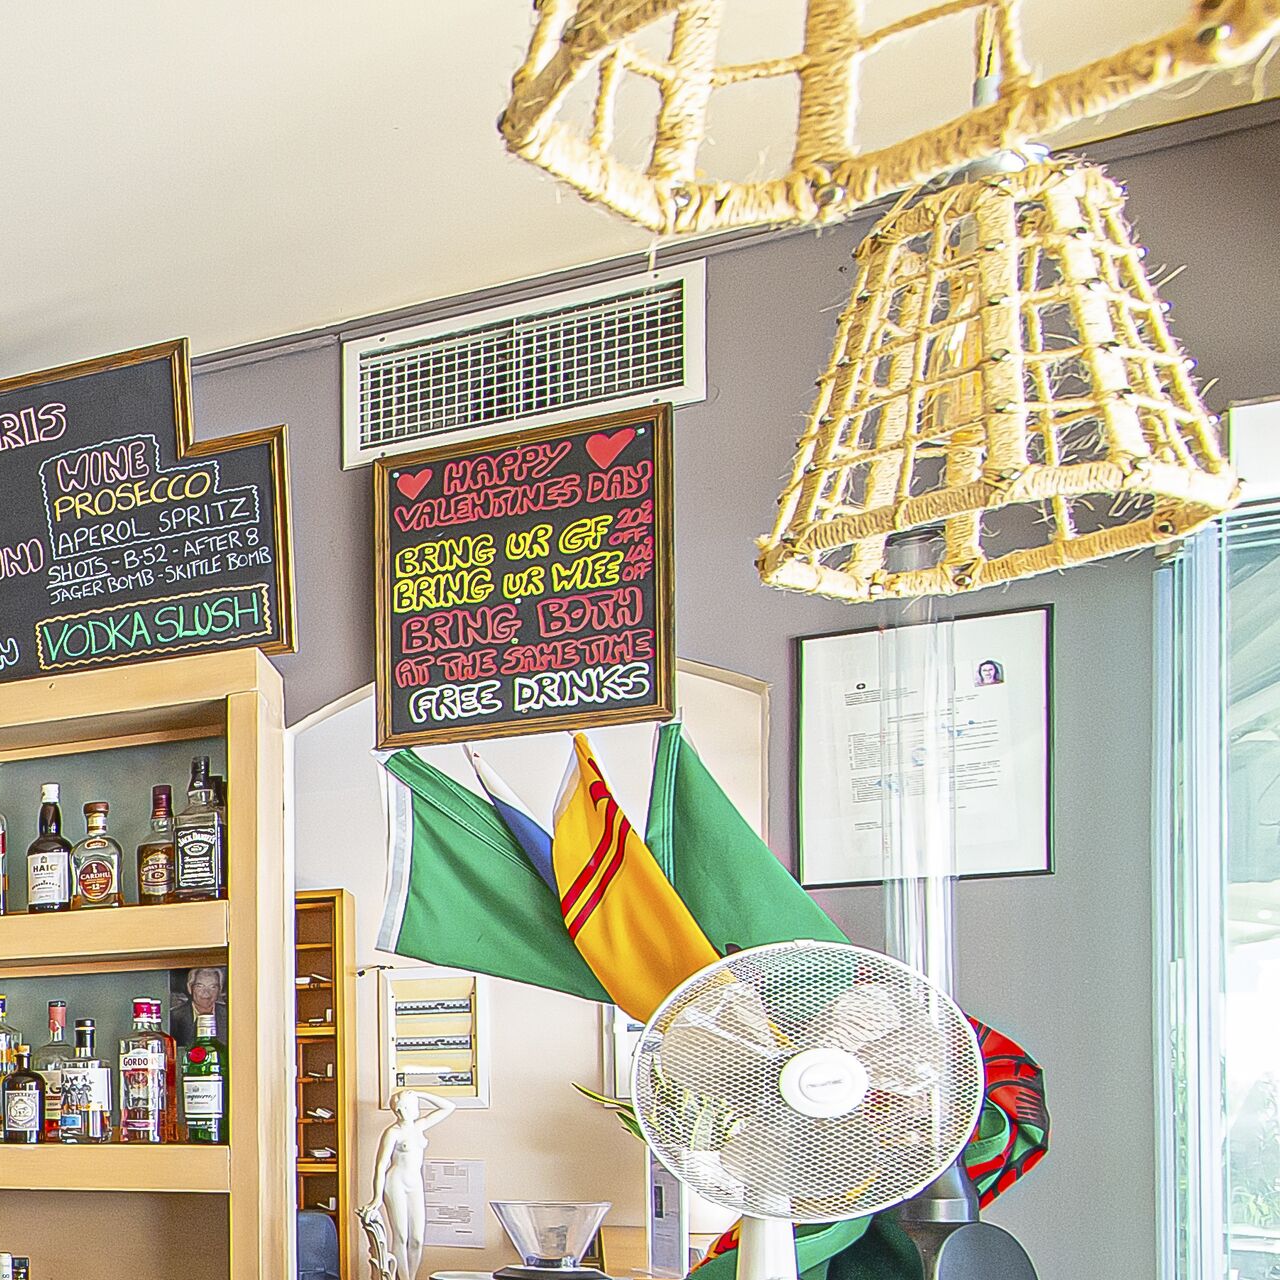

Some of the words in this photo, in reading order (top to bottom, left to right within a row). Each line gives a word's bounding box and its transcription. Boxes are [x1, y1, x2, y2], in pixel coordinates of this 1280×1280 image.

[56, 441, 149, 492] WINE
[443, 441, 572, 496] HAPPY
[54, 472, 211, 521] PROSECCO
[394, 474, 583, 533] VALENTINES
[587, 461, 654, 503] DAY
[58, 518, 150, 555] APEROL
[159, 497, 250, 532] SPRITZ
[396, 534, 496, 579] BRING
[505, 524, 553, 560] UR
[558, 515, 613, 555] GF
[609, 525, 648, 546] OFF
[48, 558, 108, 585] SHOTS
[183, 530, 242, 558] AFTER
[245, 527, 259, 546] 8
[50, 581, 104, 606] JAGER
[107, 569, 155, 593] BOMB
[165, 562, 222, 584] SKITTLE
[226, 547, 272, 572] BOMB
[622, 561, 653, 581] OFF
[393, 568, 495, 614] BRING
[503, 566, 545, 599] UR
[43, 611, 152, 661] VODKA
[154, 592, 259, 642] SLUSH
[402, 604, 522, 653] BRING
[537, 586, 643, 638] BOTH
[395, 655, 435, 688] AT
[437, 648, 498, 682] THE
[500, 641, 580, 675] SAME
[577, 628, 655, 666] TIME
[410, 680, 502, 723] FREE
[513, 662, 650, 712] DRINKS
